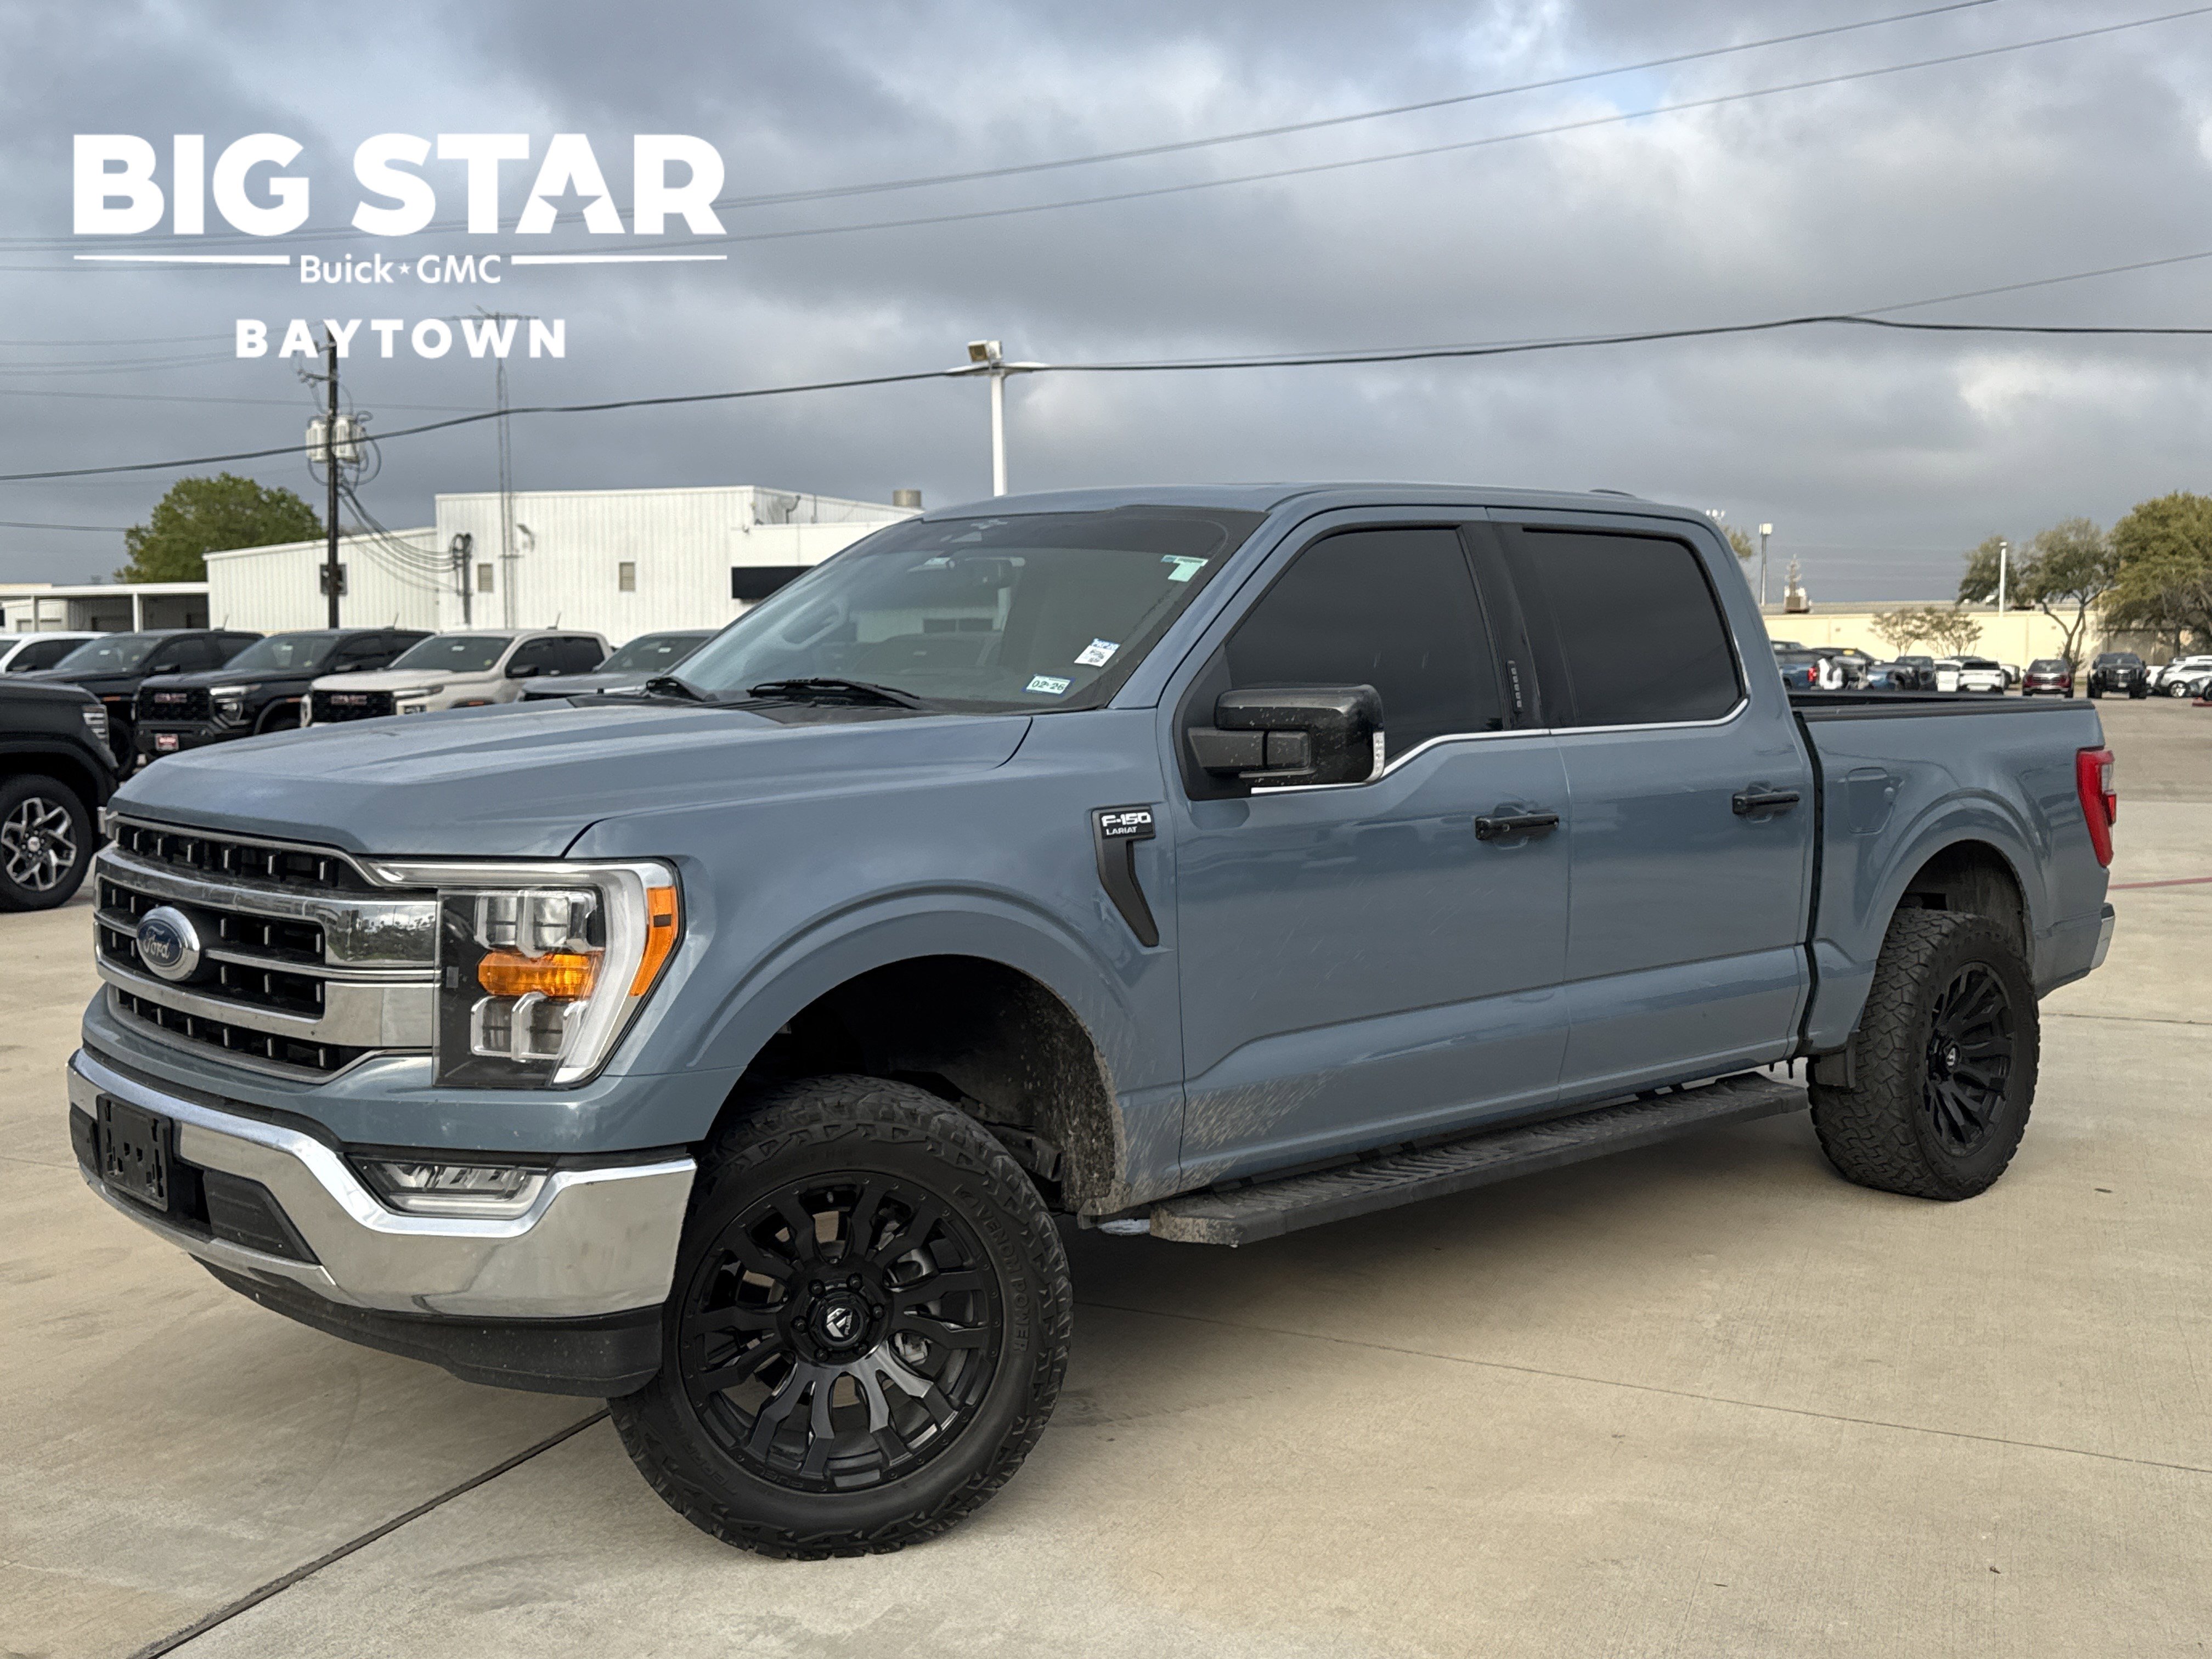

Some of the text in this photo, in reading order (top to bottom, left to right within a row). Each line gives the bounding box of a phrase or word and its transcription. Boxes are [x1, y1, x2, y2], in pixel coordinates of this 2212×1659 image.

[1101, 812, 1152, 827] F-150
[1105, 826, 1137, 836] LARIAT
[143, 926, 172, 959] Ford
[976, 1204, 1030, 1353] VENOM POWER
